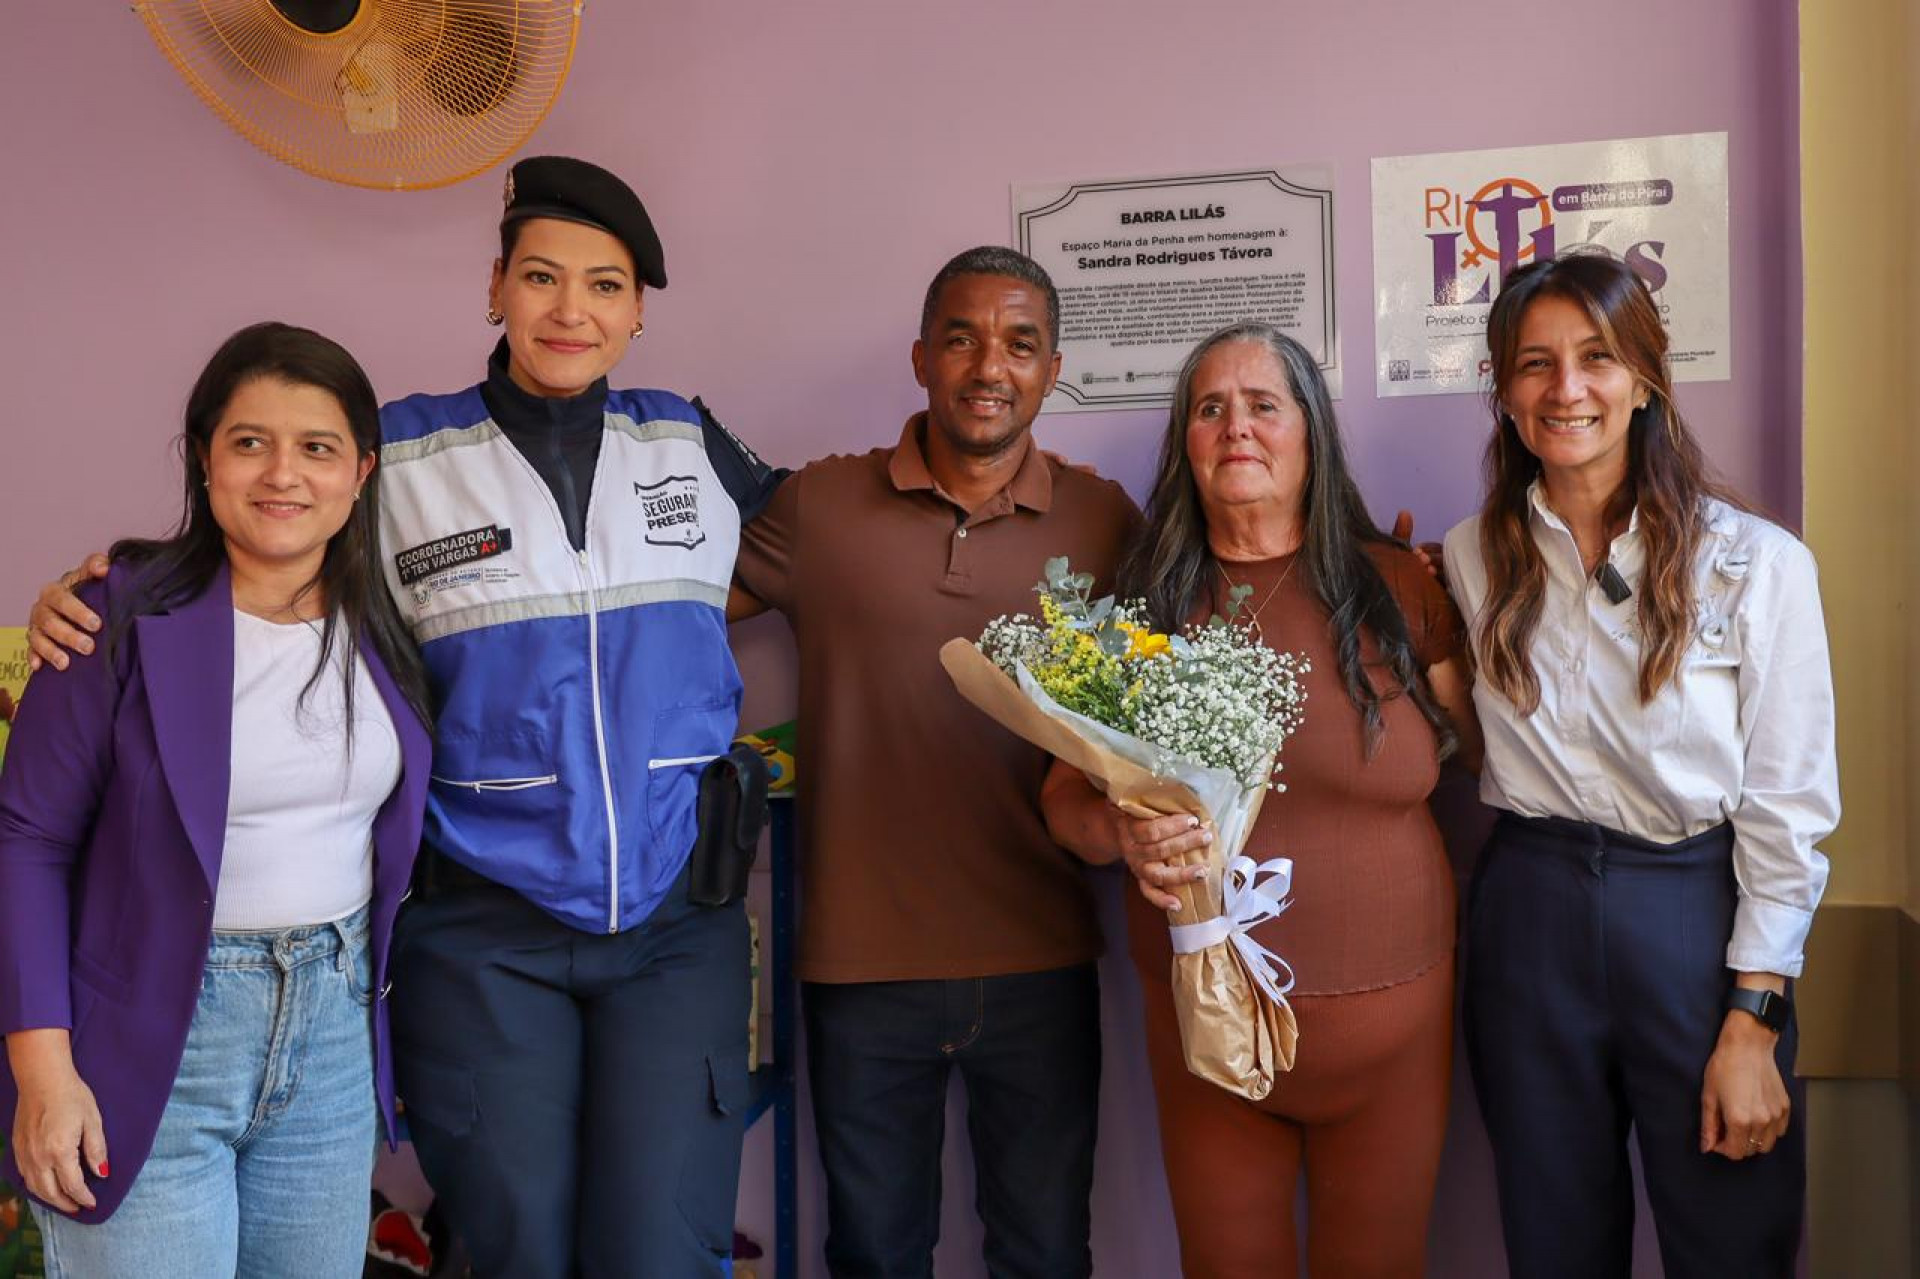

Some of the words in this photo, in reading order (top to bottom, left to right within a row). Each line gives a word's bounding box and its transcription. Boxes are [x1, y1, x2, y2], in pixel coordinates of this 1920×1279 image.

[1560, 194, 1578, 205] em
[1581, 191, 1616, 203] Barra
[1620, 190, 1633, 199] do
[1121, 209, 1176, 224] BARRA
[1180, 203, 1226, 219] LILÁS
[1062, 242, 1100, 252] Espaço
[1104, 240, 1132, 248] Maria
[1135, 238, 1148, 246] da
[1152, 235, 1184, 245] Penha
[1188, 235, 1204, 243] em
[1207, 230, 1276, 242] homenagem
[1078, 255, 1132, 269] Sandra
[1136, 250, 1215, 266] Rodrigues
[1220, 246, 1272, 260] Távora
[1426, 315, 1475, 327] Projeto
[642, 493, 697, 518] SEGURAN
[398, 528, 495, 568] COORDENADORA
[411, 560, 430, 576] TEN
[432, 546, 478, 569] VARGAS
[481, 541, 498, 553] A+
